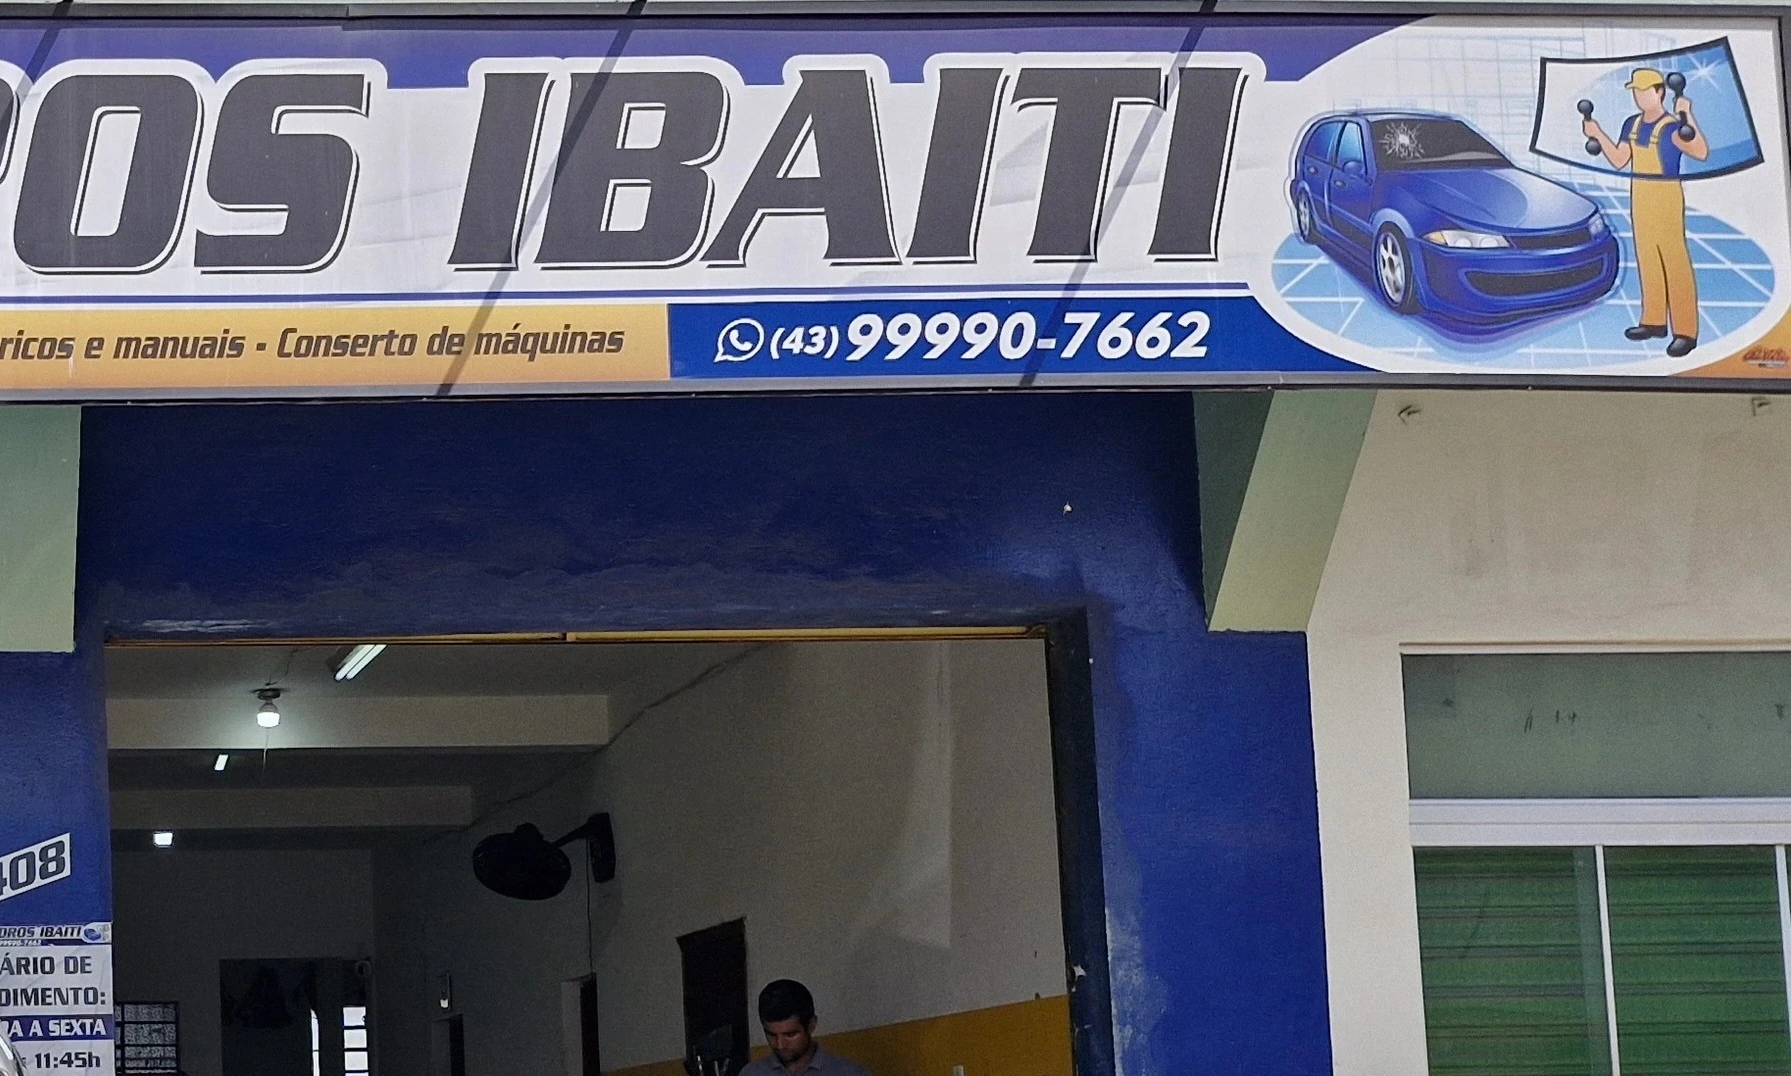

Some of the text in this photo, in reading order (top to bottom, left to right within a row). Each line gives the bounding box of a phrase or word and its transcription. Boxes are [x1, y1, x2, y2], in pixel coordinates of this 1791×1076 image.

[447, 66, 1247, 272] IBAITI
[84, 336, 105, 360] e
[113, 328, 246, 359] manuais
[277, 327, 418, 359] Conserto
[426, 325, 466, 356] de
[474, 322, 625, 362] máquinas
[770, 311, 1211, 361] (43) 99990-7662
[39, 925, 82, 938] IBAITI
[64, 955, 93, 975] DE
[28, 1019, 44, 1037] A
[49, 1018, 108, 1037] SEXTA
[34, 1051, 102, 1069] 11:45h
